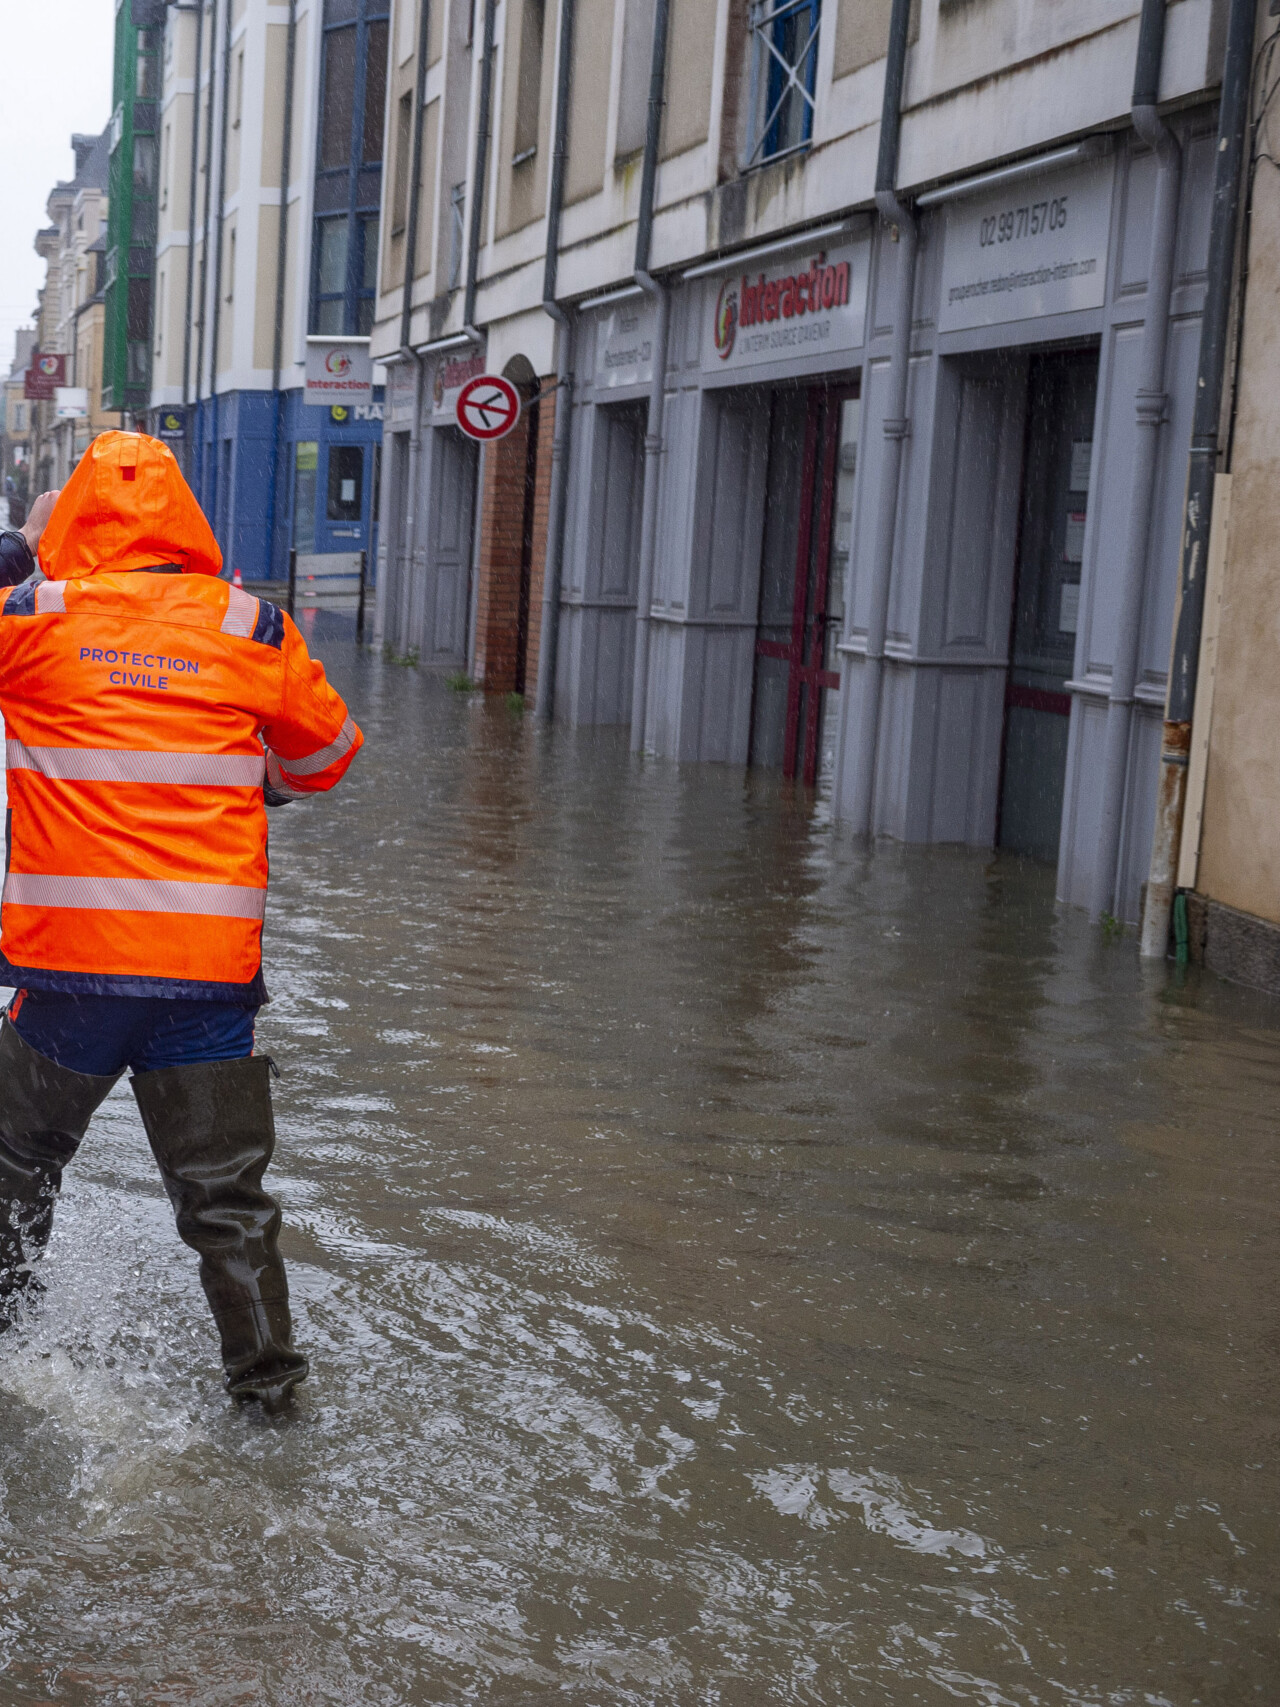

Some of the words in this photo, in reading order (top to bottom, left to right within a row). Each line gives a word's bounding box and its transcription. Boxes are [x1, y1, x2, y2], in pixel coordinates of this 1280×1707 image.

[980, 215, 995, 248] 02
[998, 210, 1014, 243] 99
[1016, 206, 1030, 239] 71
[1031, 201, 1048, 236] 57
[1049, 195, 1068, 231] 05
[739, 250, 850, 328] Interaction
[306, 378, 371, 390] Interaction
[80, 647, 199, 674] PROTECTION
[109, 671, 168, 689] CIVILE
